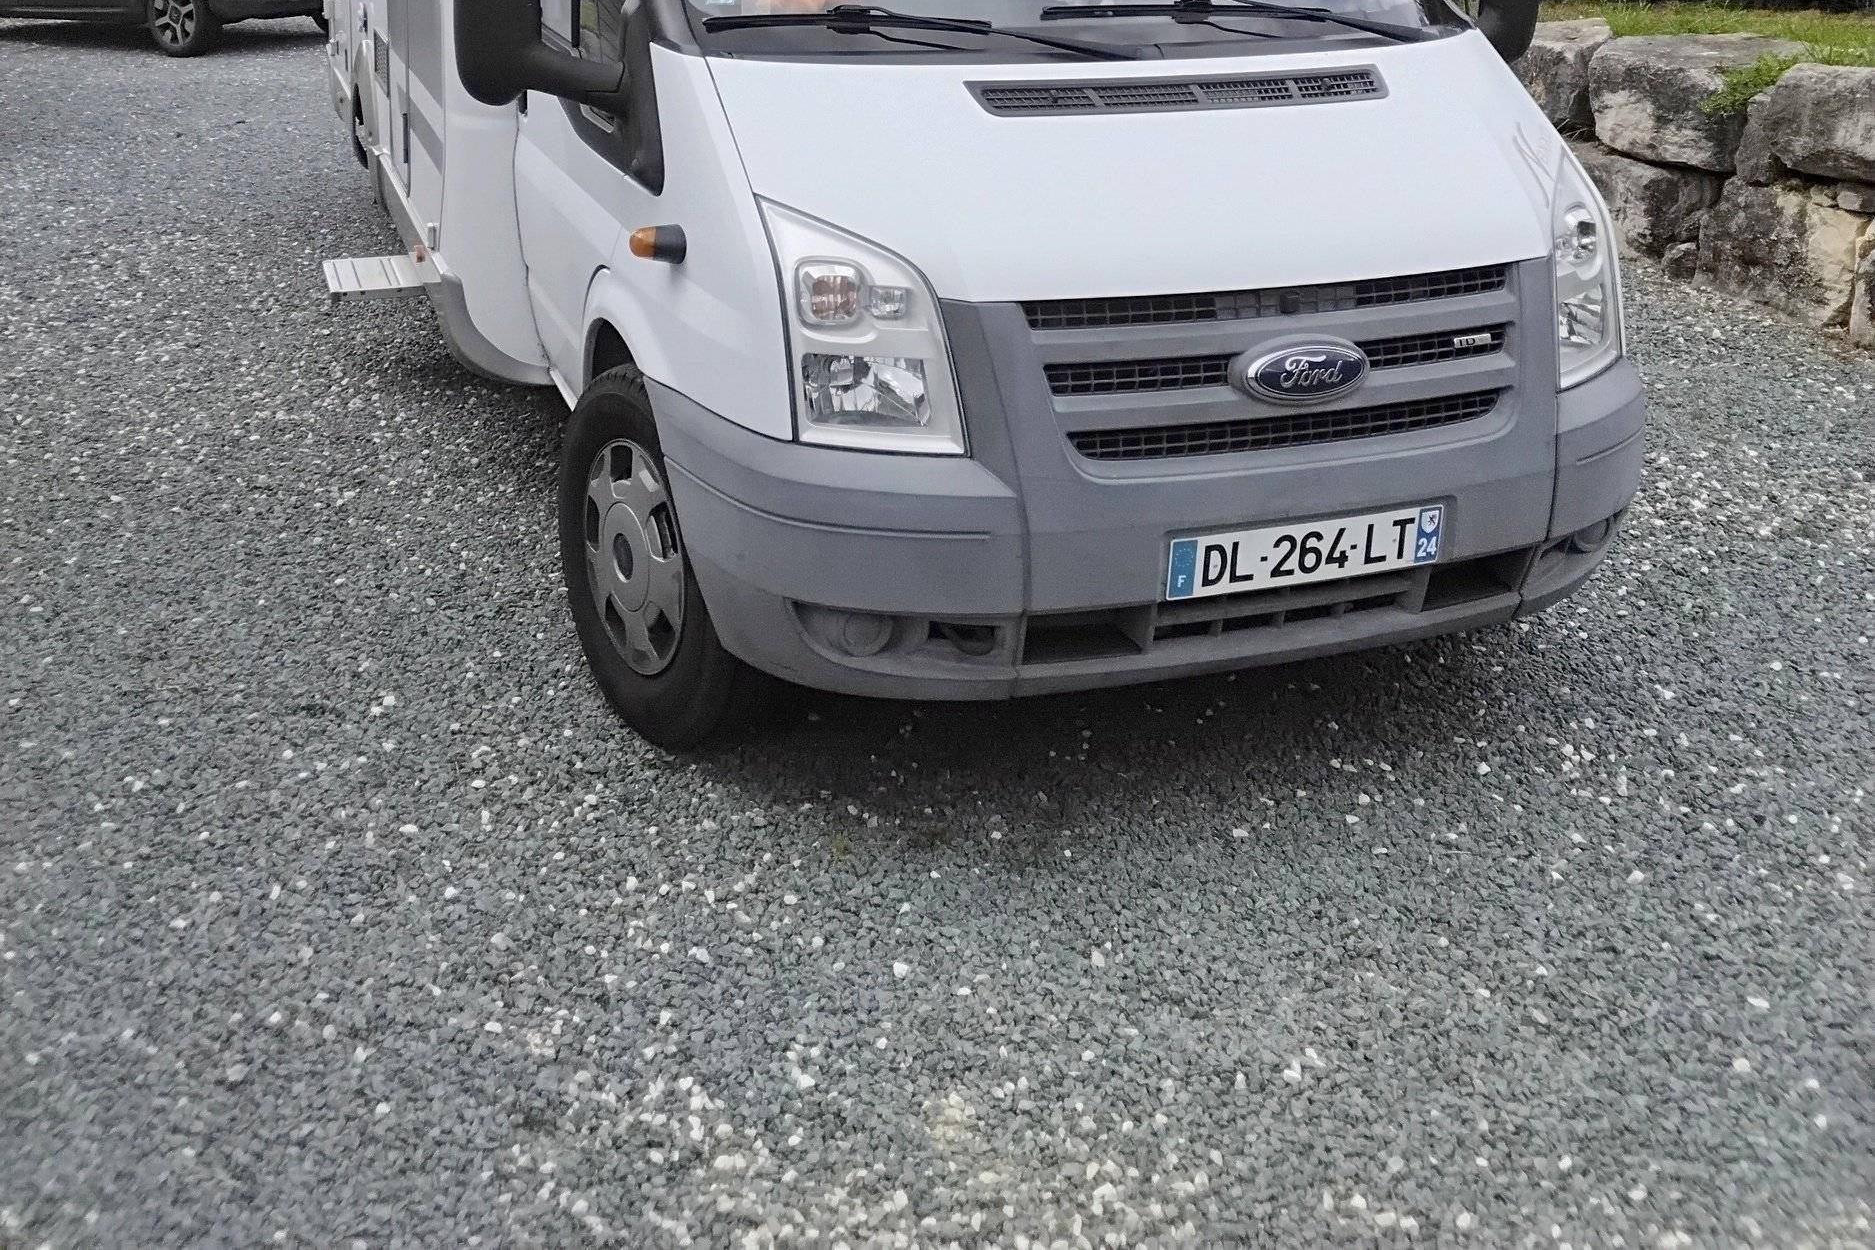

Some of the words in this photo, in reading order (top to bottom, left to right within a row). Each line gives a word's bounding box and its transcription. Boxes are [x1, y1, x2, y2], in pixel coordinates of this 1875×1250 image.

[1280, 355, 1343, 388] Ford
[1417, 536, 1437, 557] 24
[1177, 574, 1186, 588] F
